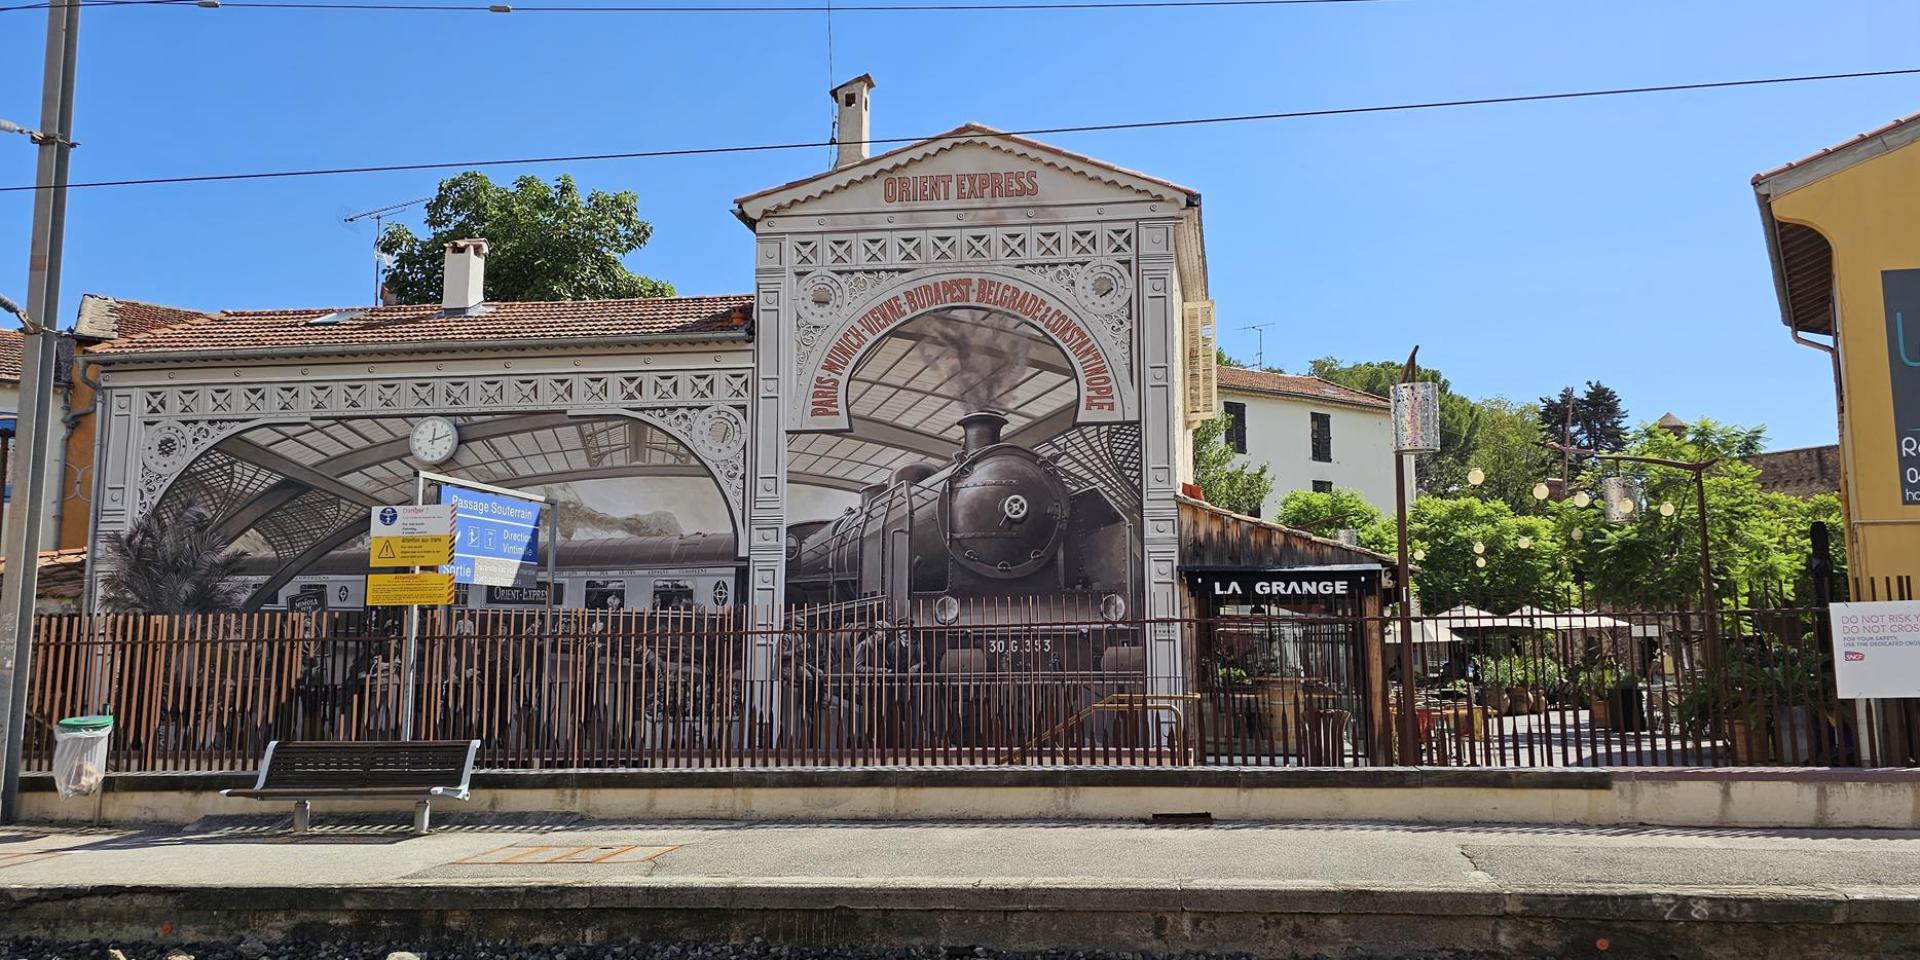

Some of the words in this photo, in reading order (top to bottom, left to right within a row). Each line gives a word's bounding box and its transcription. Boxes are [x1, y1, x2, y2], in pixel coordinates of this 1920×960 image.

[884, 175, 952, 203] ORIENT
[956, 170, 1039, 200] EXPRESS
[903, 278, 972, 312] BUDAPEST
[975, 278, 1047, 321] BELGRADE
[857, 295, 907, 336] VIENNE
[821, 325, 868, 376] MUNICH
[811, 376, 840, 417] PARIS
[1902, 436, 1920, 457] R
[1907, 467, 1920, 484] 0
[451, 494, 489, 514] Passage
[491, 502, 532, 520] Souterrain
[1214, 581, 1242, 595] LA
[1255, 580, 1348, 595] GRANGE
[295, 598, 318, 608] MIMOSA
[1842, 615, 1858, 624] DO
[1861, 615, 1885, 624] NOT
[1889, 614, 1911, 623] RISK
[1843, 625, 1859, 634] DO
[1862, 625, 1886, 633] NOT
